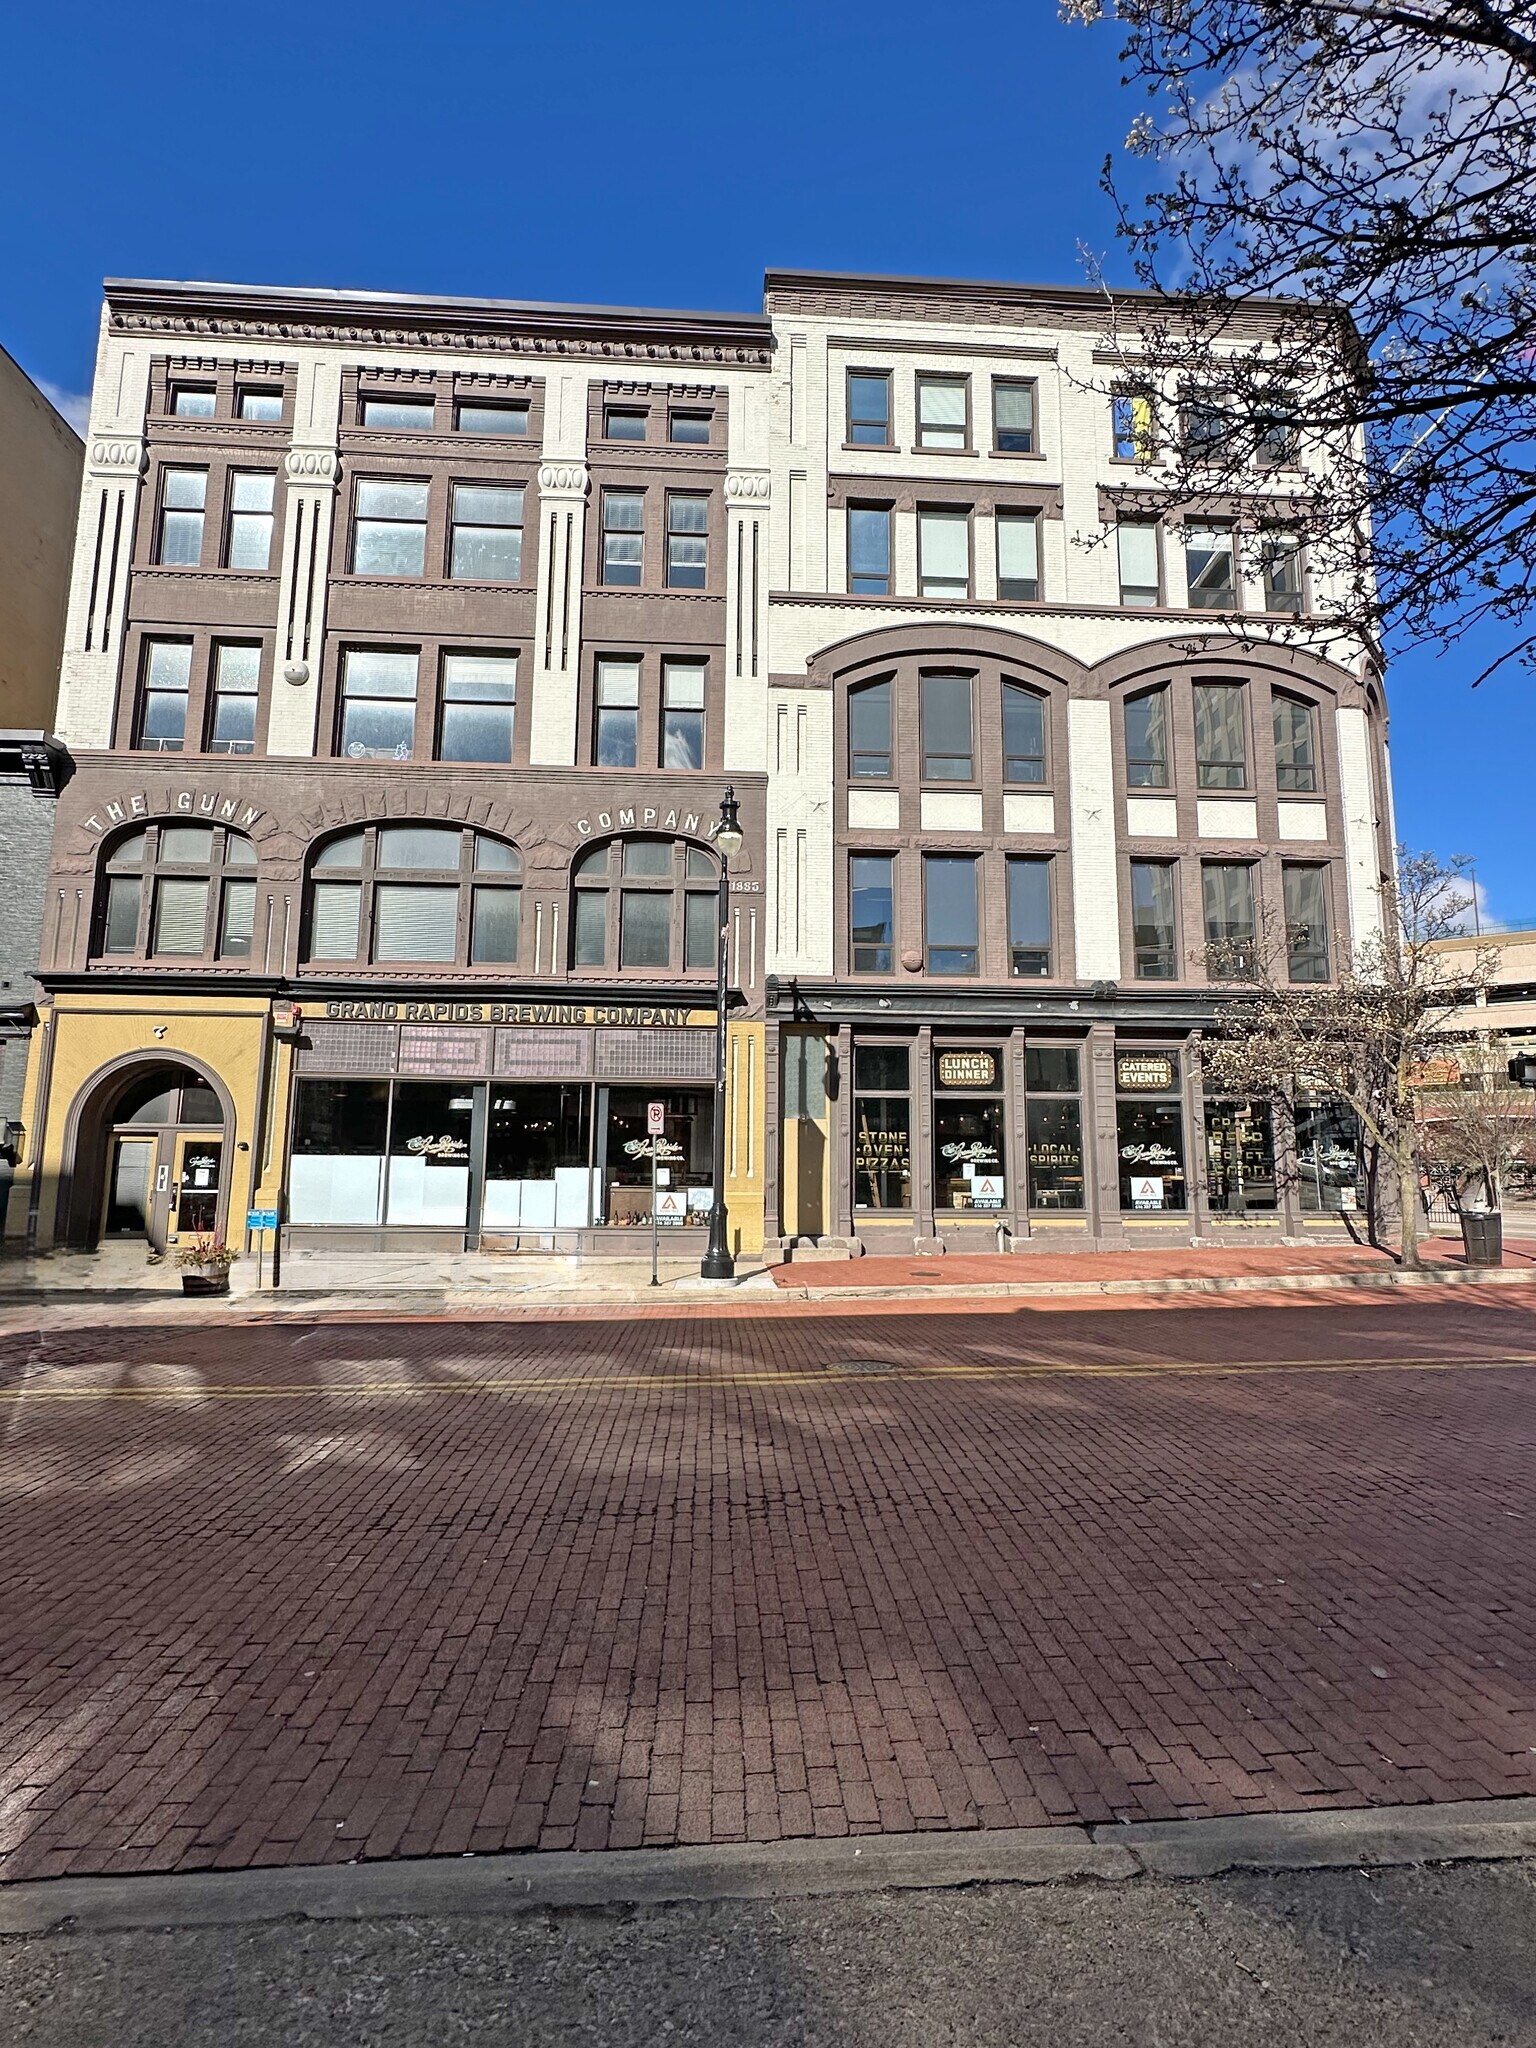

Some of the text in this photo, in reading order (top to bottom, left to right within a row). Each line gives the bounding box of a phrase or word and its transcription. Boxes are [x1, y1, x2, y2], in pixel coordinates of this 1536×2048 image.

[85, 791, 262, 833] THE GUNN
[577, 808, 725, 837] COMPANY
[326, 1000, 691, 1025] GRAND RAPIDS BREWING COMPANY
[944, 1058, 989, 1069] LUNCH
[1122, 1062, 1167, 1072] CATERED
[944, 1069, 989, 1080] DINNER
[1122, 1072, 1168, 1083] EVENTS
[858, 1131, 908, 1144] STONE
[863, 1144, 904, 1157] OVEN
[1033, 1143, 1076, 1155] LOCAL
[856, 1157, 910, 1170] PIZZAS
[1029, 1154, 1080, 1166] SPIRITS
